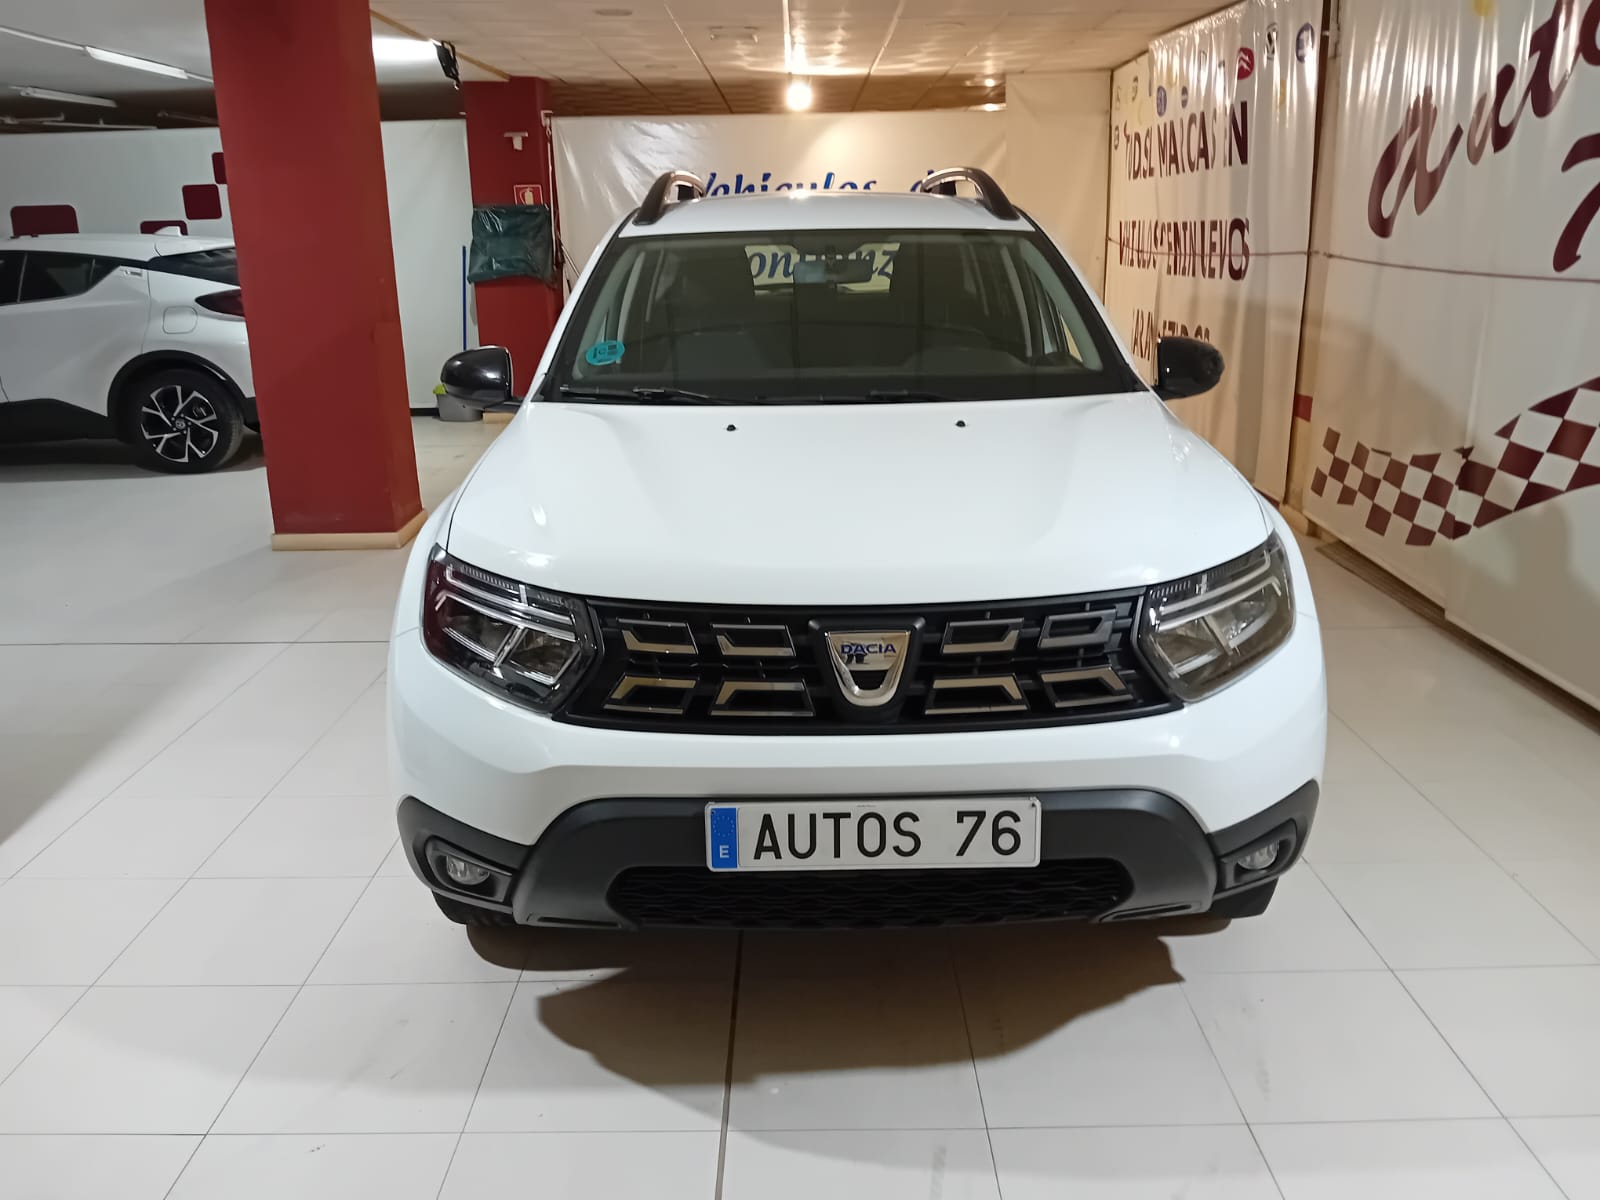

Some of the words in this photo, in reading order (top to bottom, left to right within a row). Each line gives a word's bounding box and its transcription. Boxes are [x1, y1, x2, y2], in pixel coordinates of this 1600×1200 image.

[841, 643, 897, 655] DACIA
[719, 845, 729, 858] E
[753, 811, 922, 860] AUTOS
[955, 810, 1021, 857] 76
